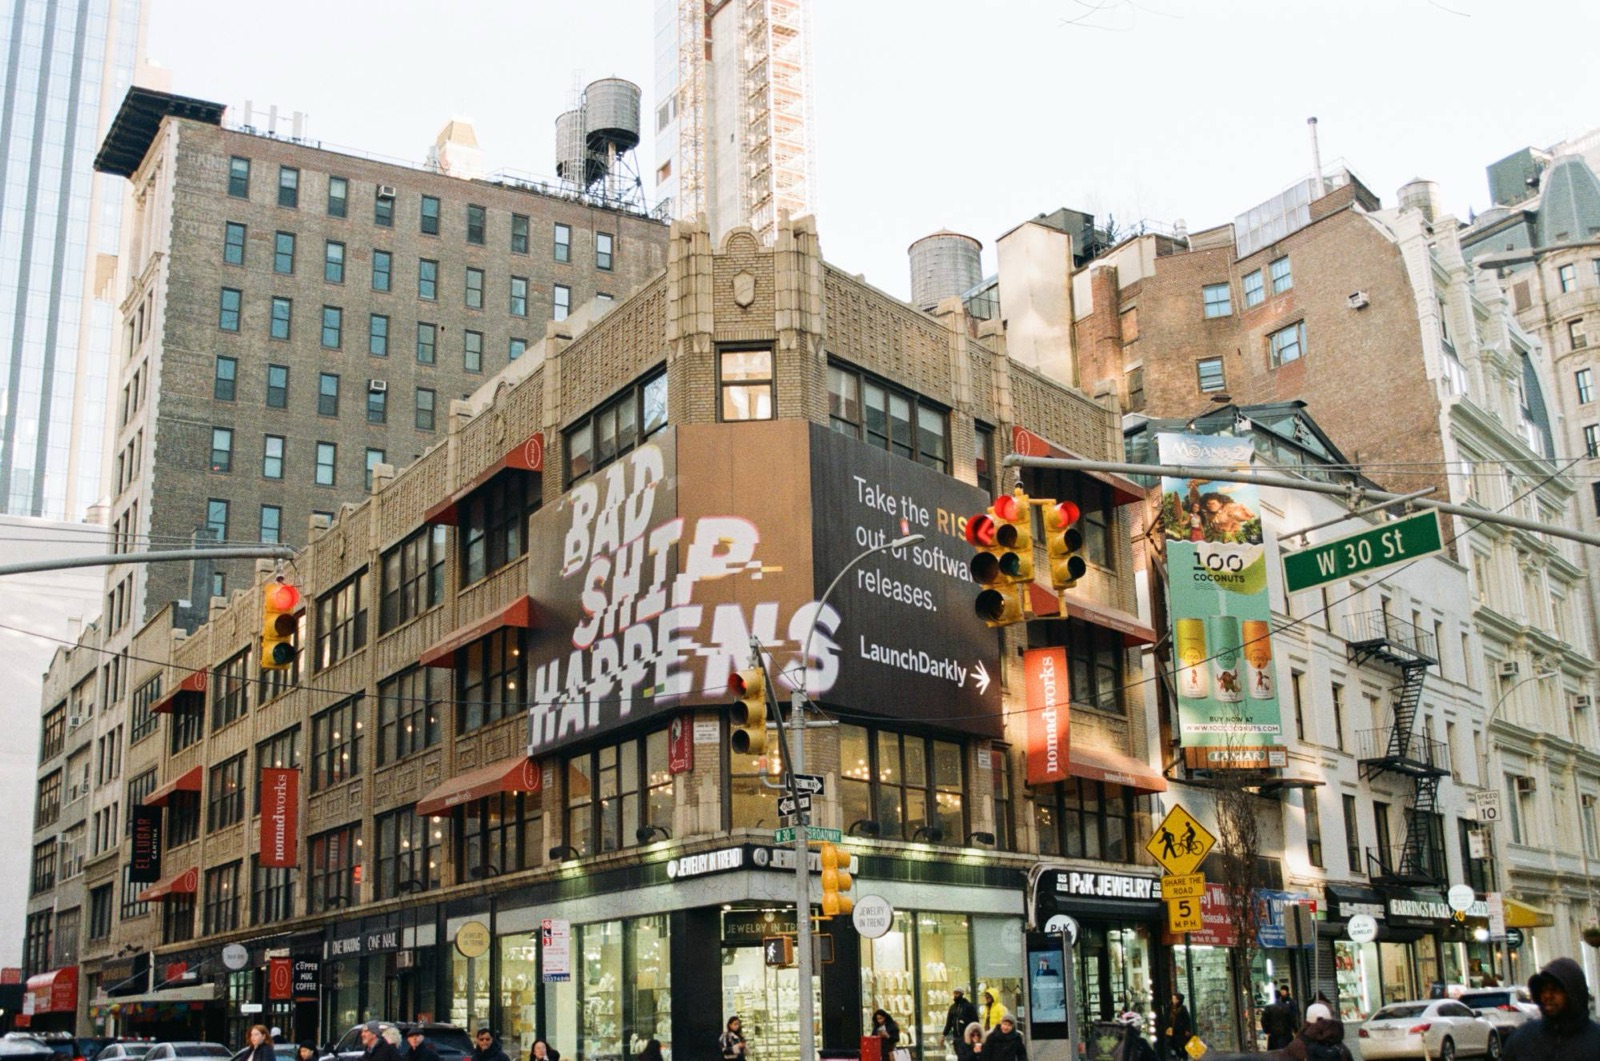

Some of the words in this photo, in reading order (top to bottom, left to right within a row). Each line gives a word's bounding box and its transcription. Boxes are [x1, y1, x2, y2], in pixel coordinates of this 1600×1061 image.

[1171, 441, 1231, 460] MOANA
[1233, 445, 1246, 461] 2
[561, 445, 663, 577] BAD
[853, 475, 897, 516] Take
[901, 496, 929, 527] the
[936, 508, 969, 541] RIS
[856, 526, 887, 554] out
[912, 546, 973, 583] softwa
[1316, 550, 1335, 577] W
[1345, 539, 1372, 569] 30
[1381, 529, 1405, 558] St
[1193, 552, 1243, 573] 100
[1193, 573, 1245, 583] COCONUTS
[858, 568, 937, 612] releases.
[860, 635, 967, 687] LaunchDarkly
[527, 600, 843, 757] HAPPENS
[1039, 656, 1058, 774] nomadworks
[1477, 792, 1498, 800] SPEED
[1479, 799, 1496, 807] LIMIT
[782, 800, 793, 811] ONE
[1481, 807, 1497, 819] 10
[272, 774, 287, 861] nomadworks
[136, 818, 151, 853] LUGAR
[776, 831, 781, 842] W
[782, 829, 791, 841] 30
[135, 857, 150, 869] EL
[677, 854, 708, 877] JEWELRY
[717, 847, 743, 869] TREND
[1069, 872, 1095, 895] P&K
[1096, 875, 1153, 898] JEWELRY
[1164, 878, 1186, 886] SHARE
[1189, 876, 1202, 884] THE
[1173, 887, 1193, 895] ROAD
[860, 906, 884, 916] JEWELRY
[1179, 900, 1191, 918] 5
[1390, 899, 1428, 917] EARRINGS
[726, 923, 767, 934] JEWELRY
[771, 923, 780, 932] IN
[867, 918, 886, 928] TREND
[300, 972, 313, 980] MUG
[295, 982, 316, 991] COFFEE
